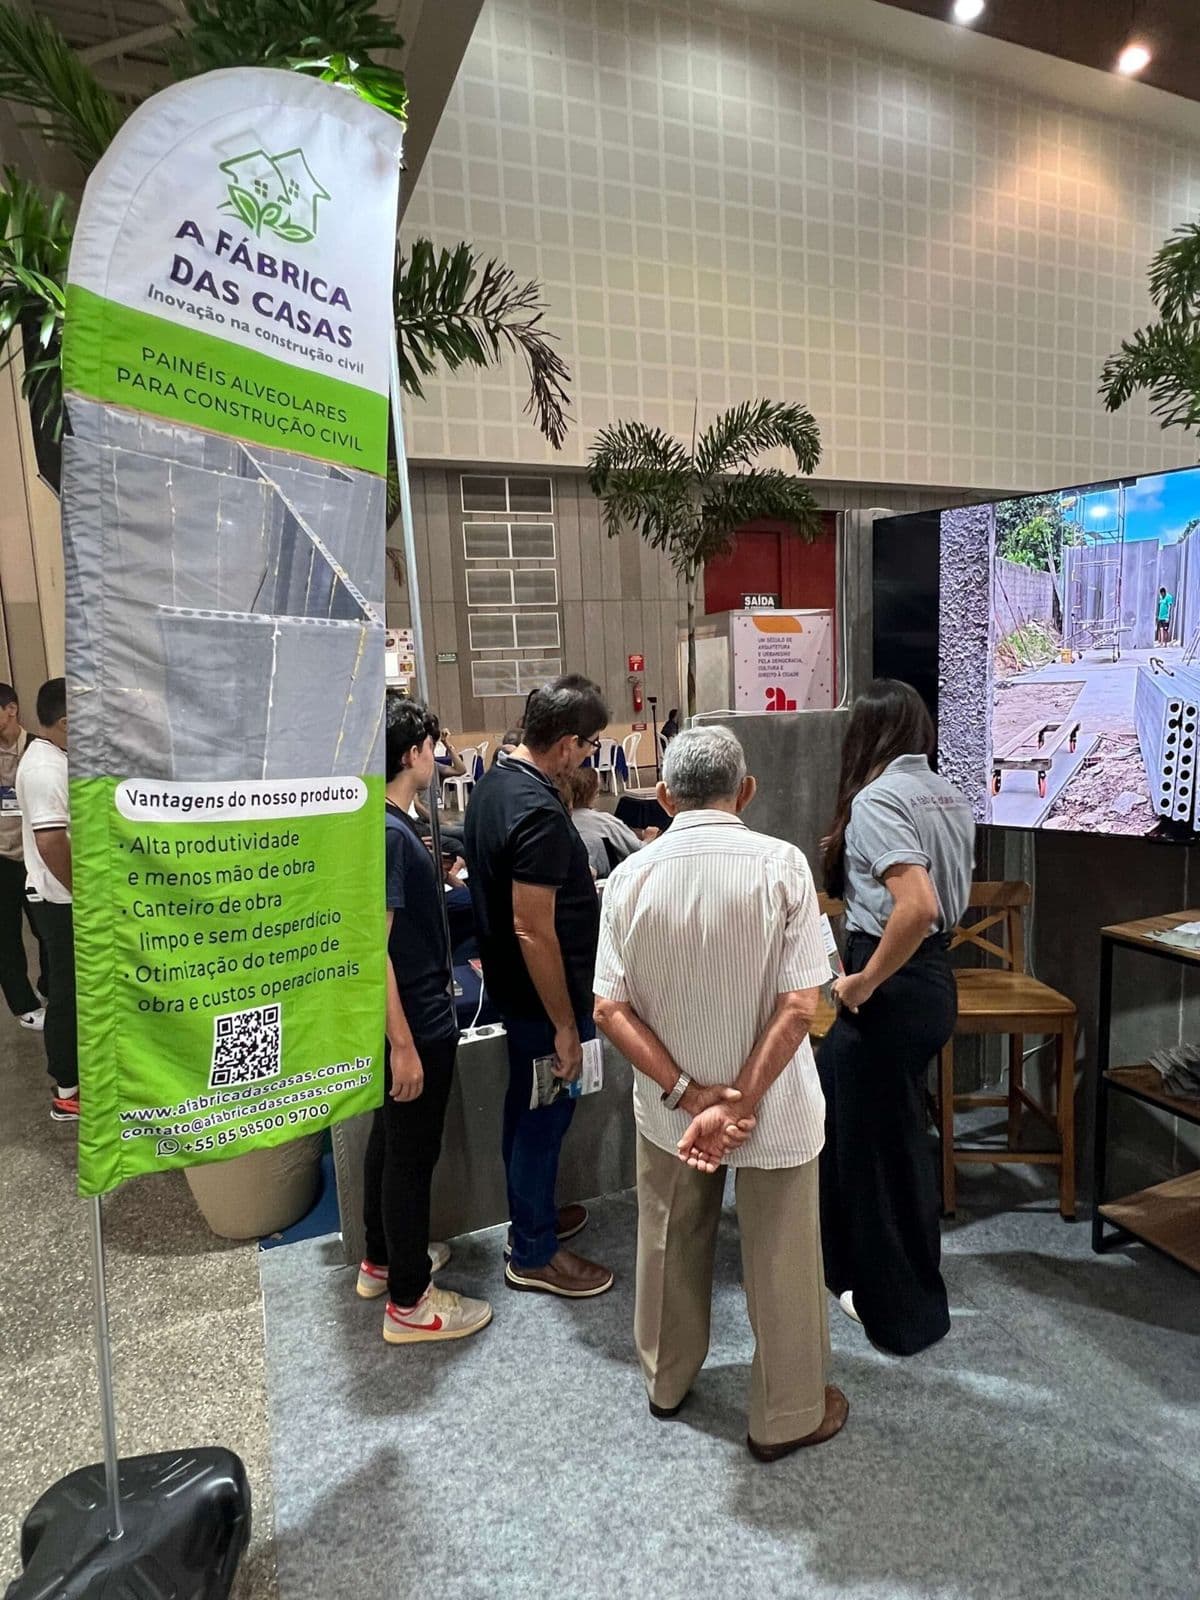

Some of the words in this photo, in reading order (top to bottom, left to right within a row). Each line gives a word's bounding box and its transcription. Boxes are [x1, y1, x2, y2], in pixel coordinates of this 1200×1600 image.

[175, 219, 205, 247] A
[215, 229, 352, 312] FÁBRICA
[170, 253, 239, 305] DAS
[252, 291, 352, 348] CASAS
[148, 284, 225, 324] Inovação
[231, 318, 250, 333] na
[255, 327, 333, 363] construção
[338, 355, 364, 375] civil
[117, 368, 178, 399] PARA
[184, 388, 316, 438] CONSTRUÇÃO
[320, 428, 363, 451] CIVIL
[142, 347, 226, 386] PAINÉIS
[231, 376, 347, 423] ALVEOLARES
[745, 594, 774, 606] SAÍDA
[126, 789, 224, 812] Vantagens
[228, 791, 246, 807] do
[251, 792, 297, 806] nosso
[300, 786, 359, 806] produto:
[130, 836, 170, 855] Alta
[176, 830, 299, 858] produtividade
[128, 871, 139, 885] e
[145, 870, 211, 886] menos
[216, 864, 253, 883] mão
[259, 861, 279, 879] de
[283, 858, 315, 875] obra
[133, 899, 214, 918] Canteiro
[219, 896, 241, 914] de
[245, 893, 282, 911] obra
[140, 932, 190, 951] limpo
[194, 932, 204, 946] e
[208, 928, 247, 944] sem
[252, 909, 341, 940] desperdício
[136, 956, 238, 983] Otimização
[242, 952, 265, 970] do
[269, 945, 317, 967] tempo
[320, 936, 340, 954] de
[138, 997, 184, 1013] obra
[190, 995, 199, 1010] e
[202, 985, 256, 1009] custos
[261, 960, 360, 998] operacionais
[119, 1056, 372, 1123] www.afabricadascasas.com.br
[121, 1072, 373, 1140] contato@afabricadascasas.com.br
[184, 1135, 214, 1153] +55
[217, 1130, 237, 1146] 85
[239, 1116, 285, 1140] 98500
[288, 1103, 330, 1124] 9700
